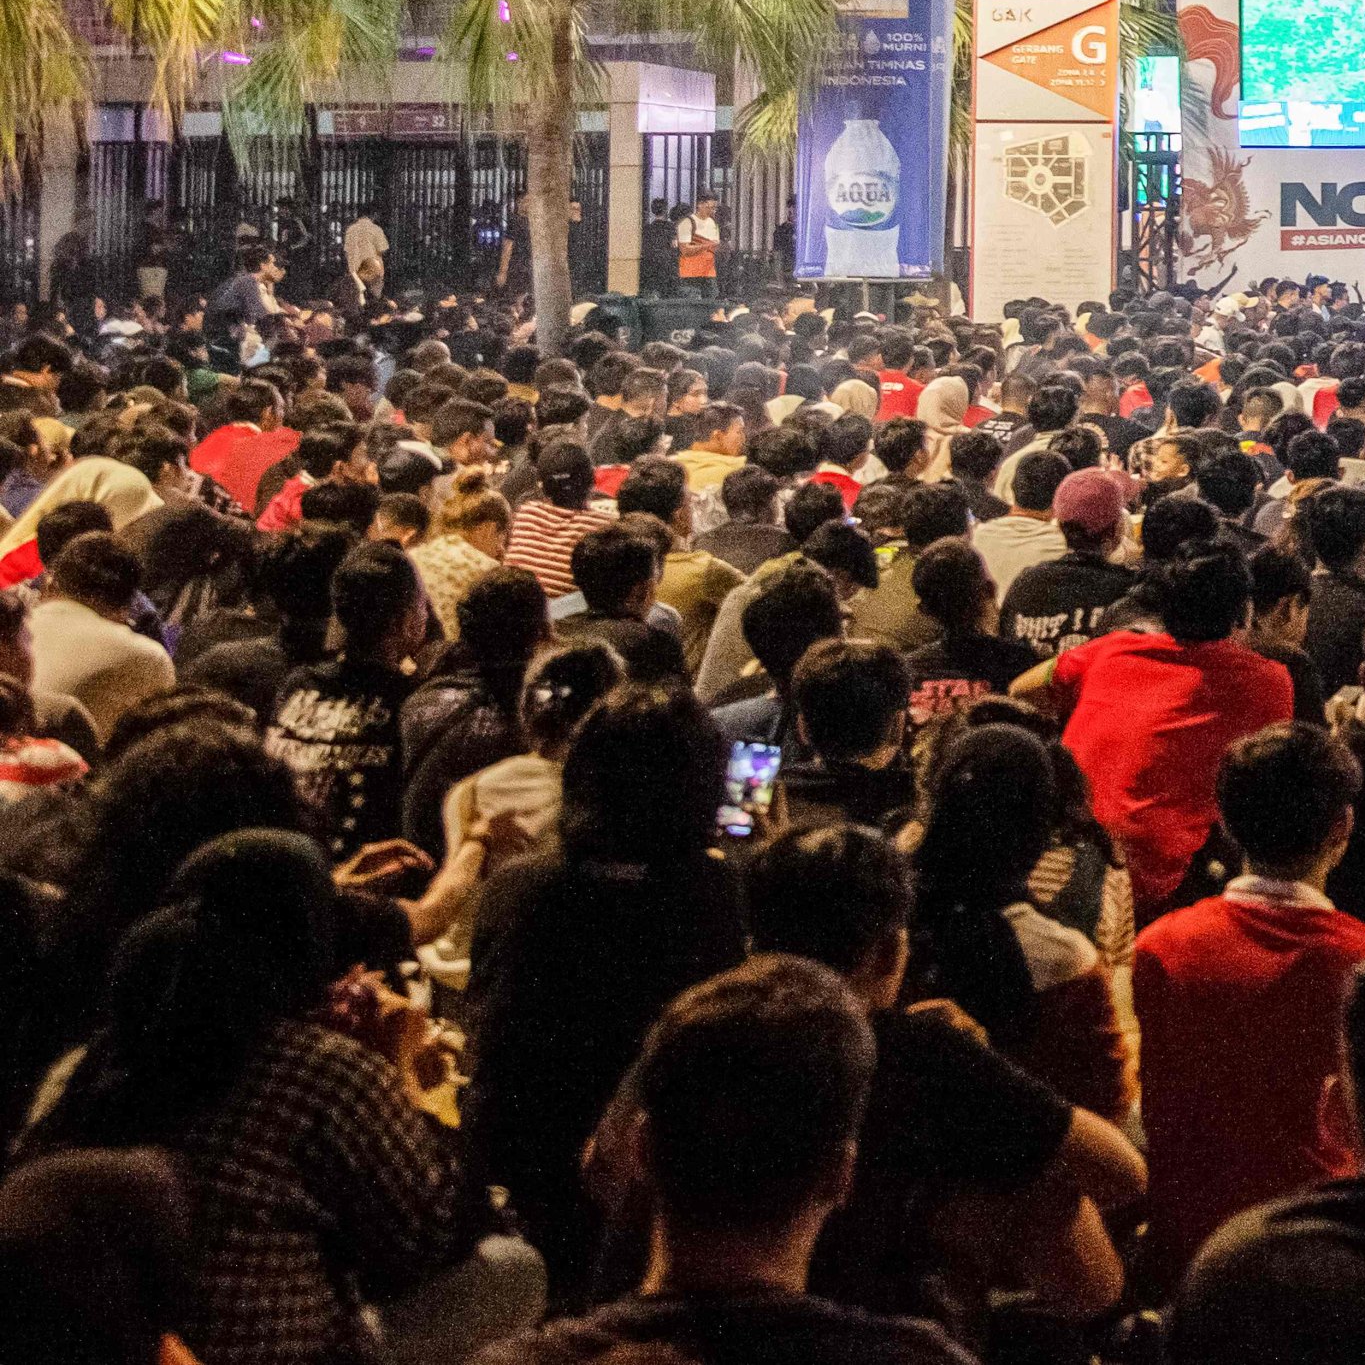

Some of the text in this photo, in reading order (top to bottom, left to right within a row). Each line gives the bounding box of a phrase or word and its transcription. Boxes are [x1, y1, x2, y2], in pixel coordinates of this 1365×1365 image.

[887, 32, 924, 42] 100%
[883, 43, 928, 52] MURNI
[1072, 25, 1107, 65] G
[1011, 55, 1038, 65] GATE
[867, 60, 928, 71] TIMNAS
[835, 181, 891, 207] AQUA
